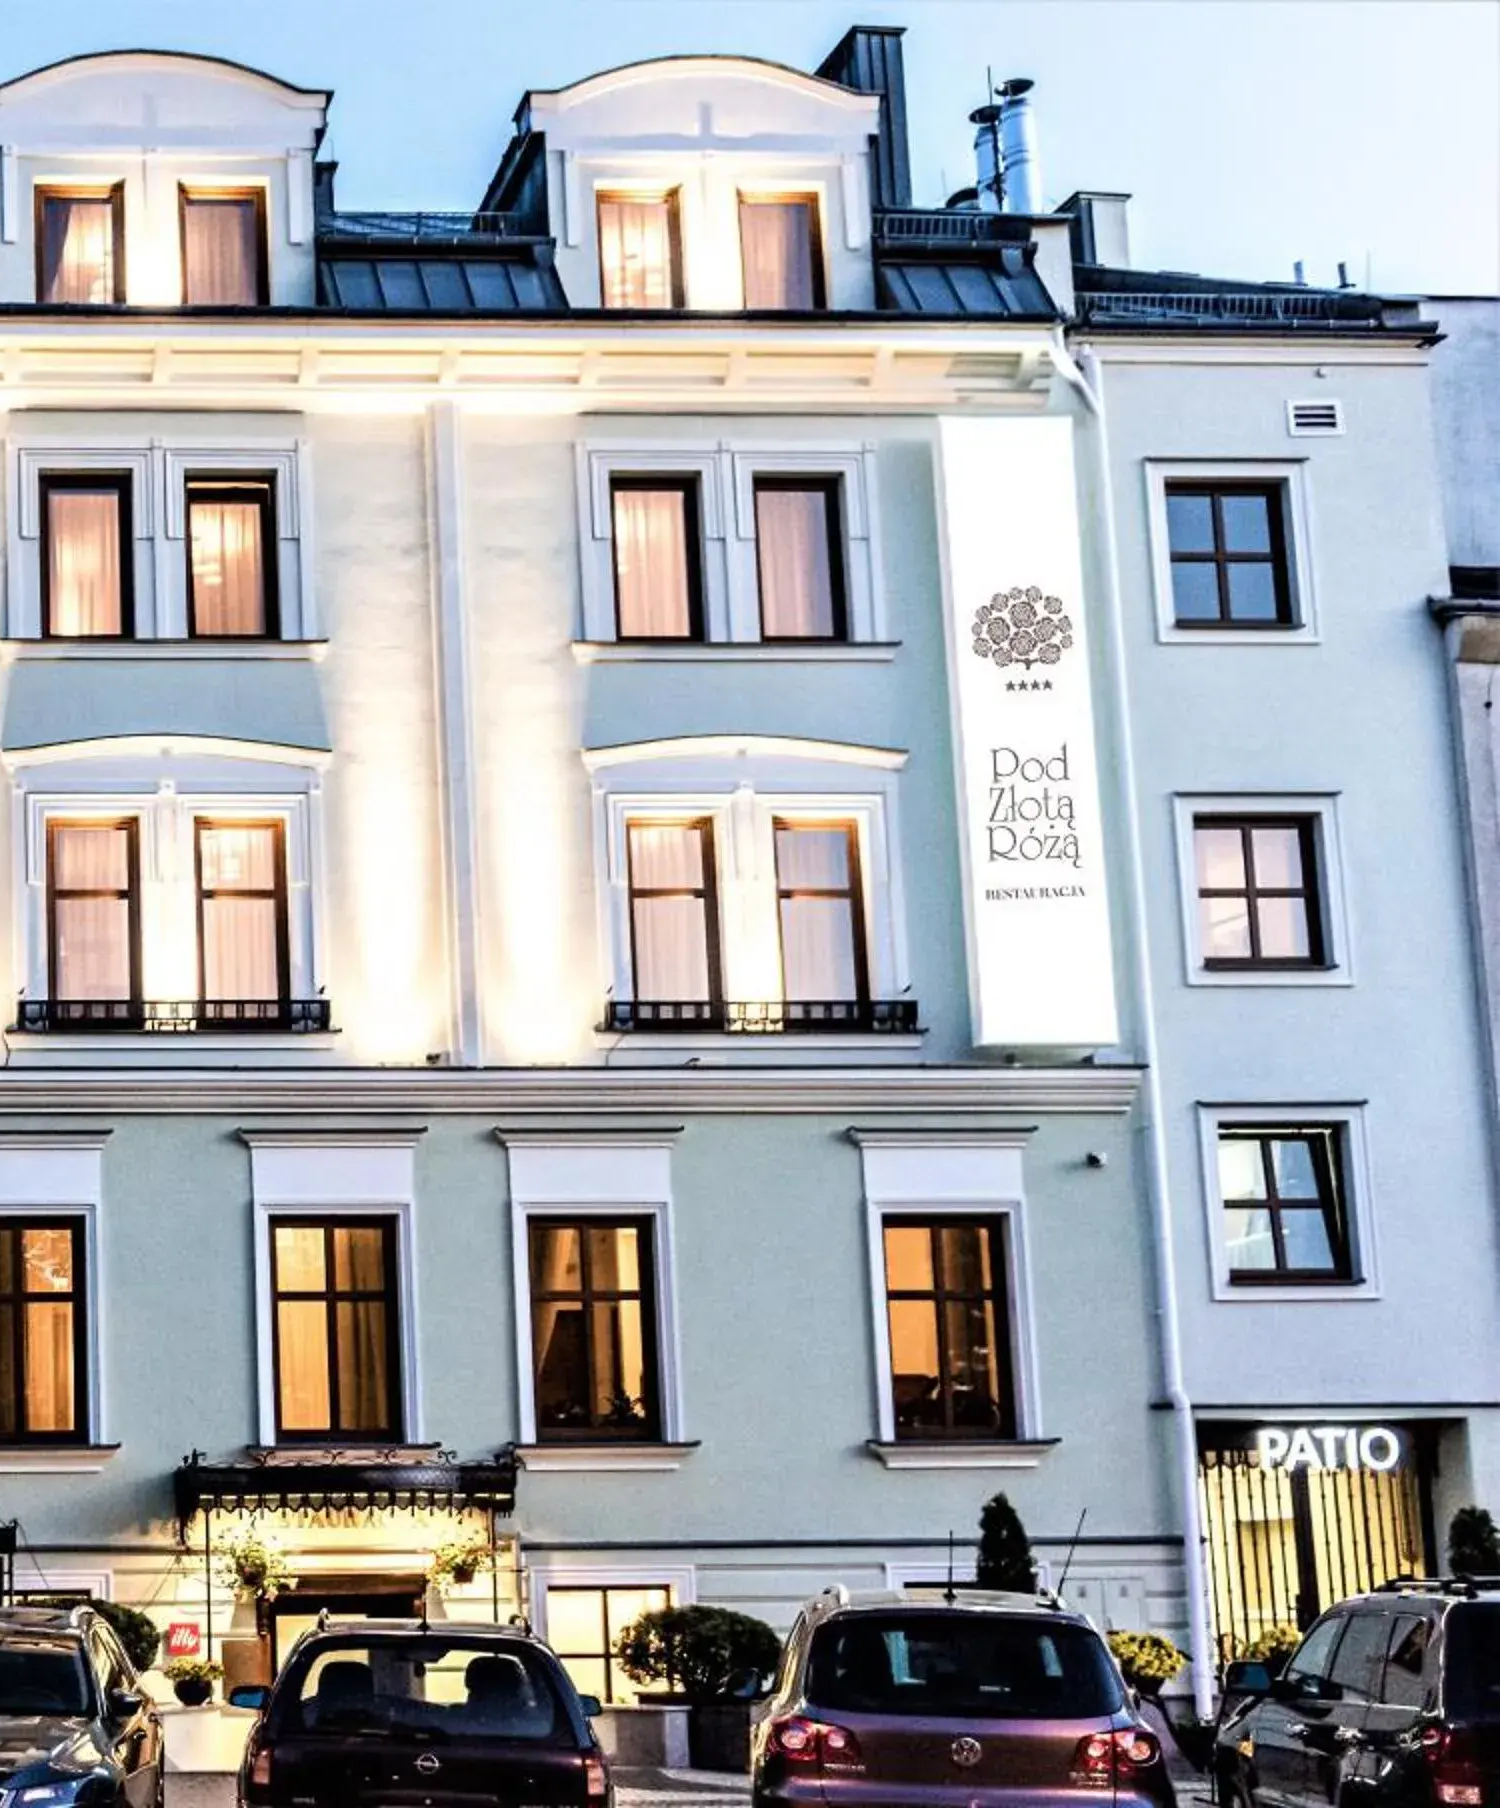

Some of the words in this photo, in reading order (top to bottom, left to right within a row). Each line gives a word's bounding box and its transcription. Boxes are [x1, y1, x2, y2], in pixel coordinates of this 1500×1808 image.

[990, 743, 1070, 783] Pod
[988, 784, 1076, 830] Złotą
[986, 824, 1083, 868] Różą
[985, 885, 1086, 901] RESTAURACJA
[1257, 1426, 1400, 1471] PATIO
[171, 1627, 198, 1650] illy
